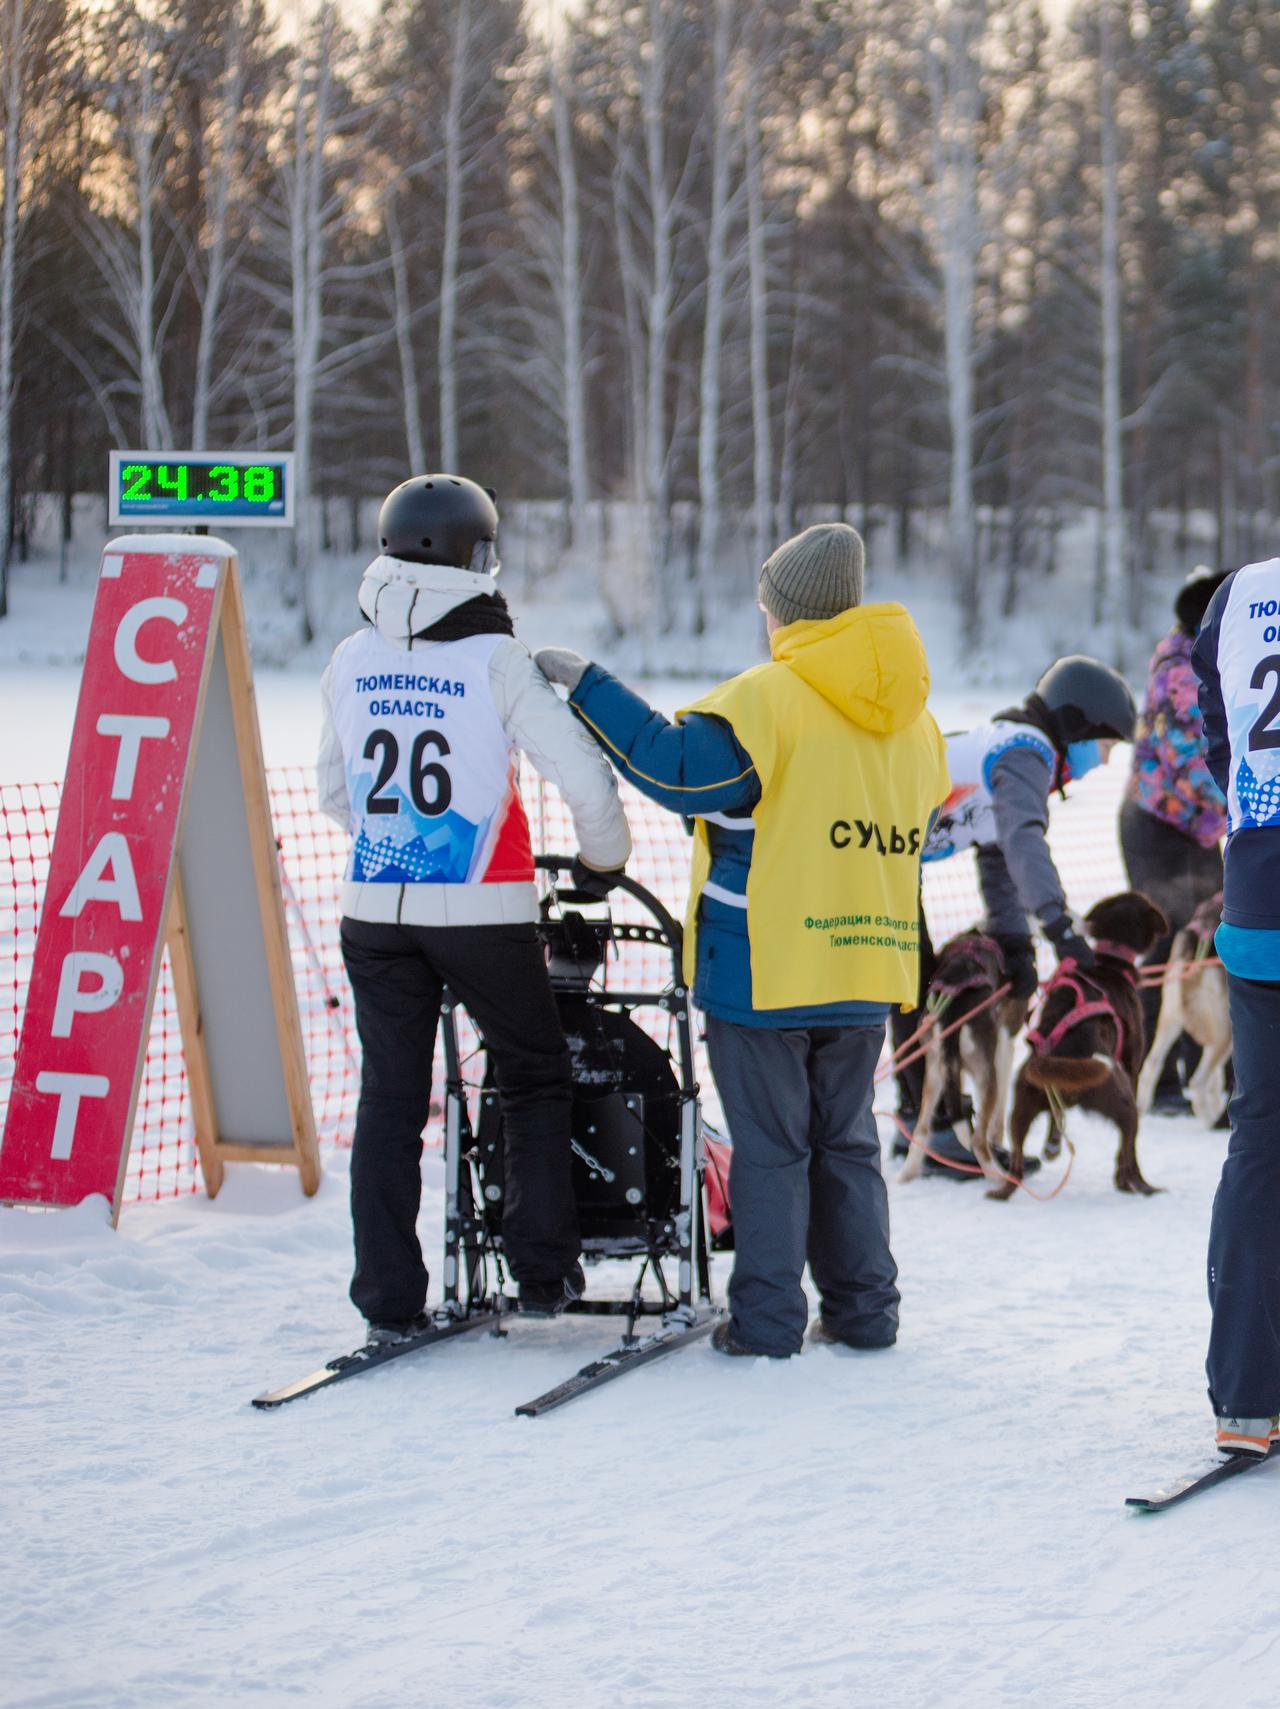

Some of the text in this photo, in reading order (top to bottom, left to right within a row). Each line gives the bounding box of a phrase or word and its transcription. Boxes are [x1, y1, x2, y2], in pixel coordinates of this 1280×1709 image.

[122, 465, 275, 502] 24.38
[355, 674, 465, 698] ТЮМЕНСКАЯ
[369, 700, 445, 719] ОБЛАСТЬ
[363, 728, 452, 816] 26
[36, 596, 188, 1160] СТАРТ
[804, 914, 871, 931] Федерация
